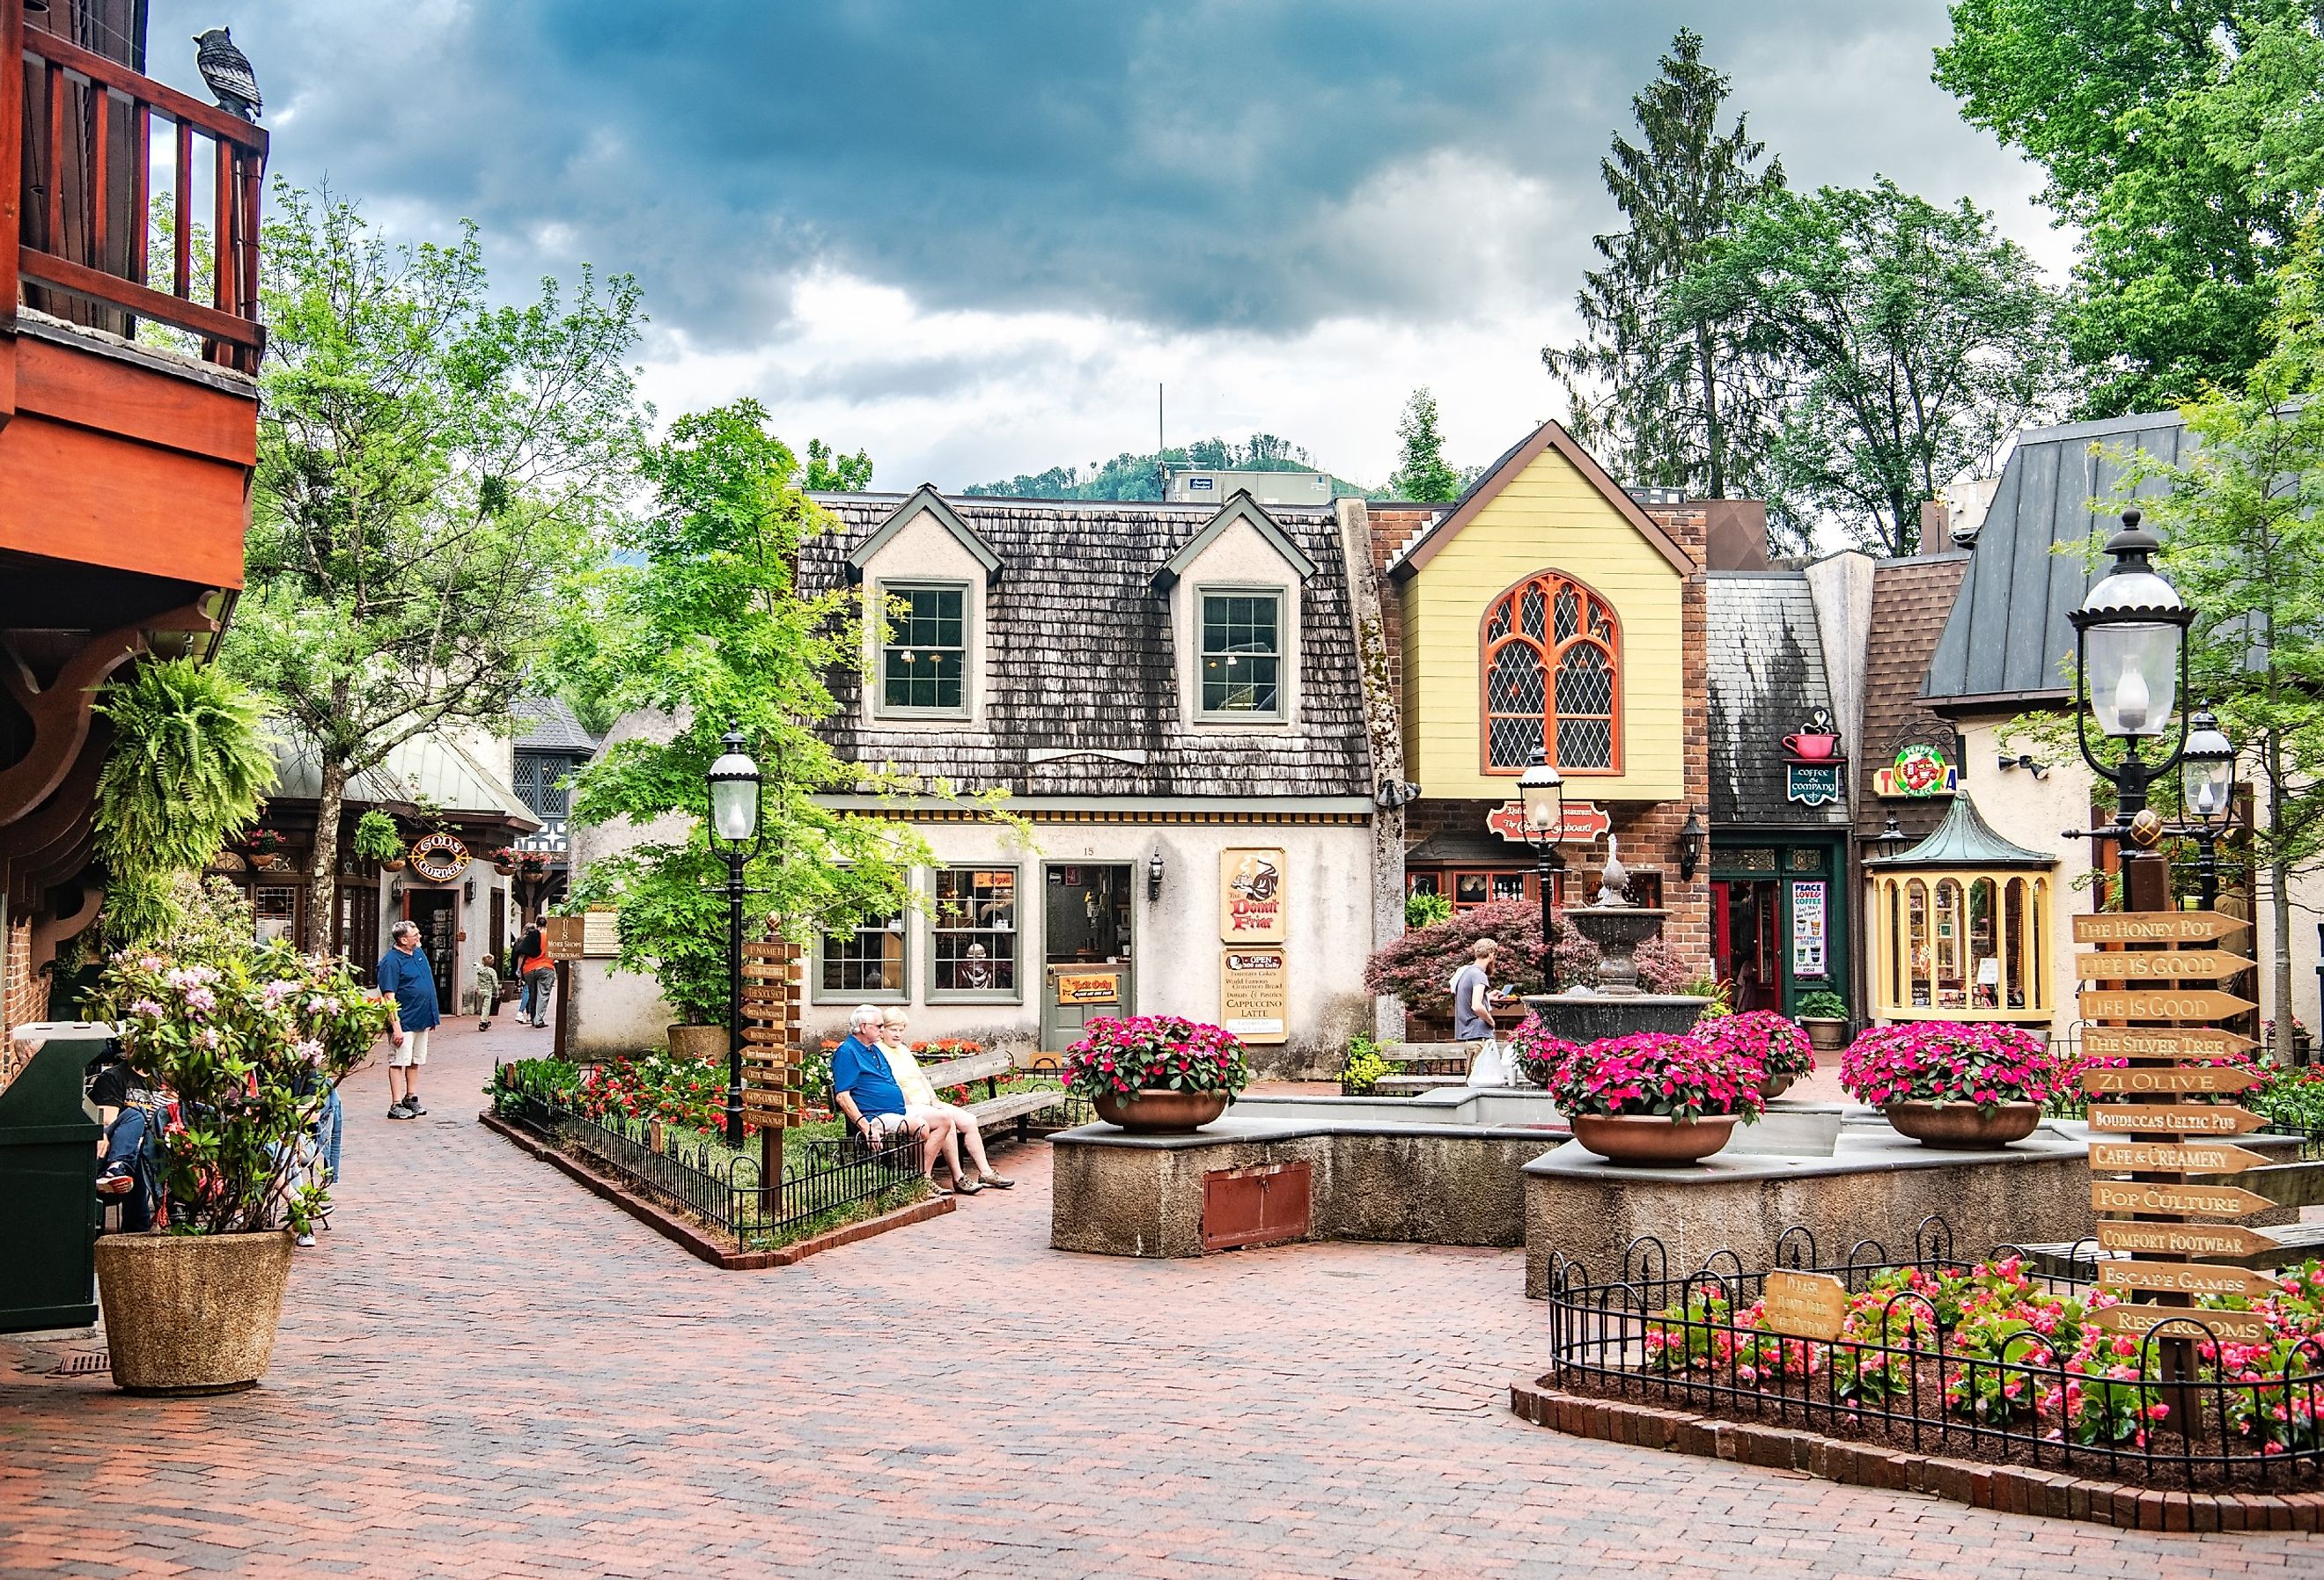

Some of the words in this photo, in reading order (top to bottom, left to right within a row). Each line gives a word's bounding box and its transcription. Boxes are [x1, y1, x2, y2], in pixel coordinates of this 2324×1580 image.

[1905, 746, 1935, 755] PEPPER
[1904, 786, 1934, 796] PALACE
[1504, 819, 1517, 828] The
[1084, 847, 1094, 856] 15
[419, 861, 466, 878] CORNER
[1230, 899, 1279, 915] Donut
[1231, 913, 1273, 930] Friar
[2078, 922, 2111, 937] THE
[2115, 921, 2175, 937] HONEY
[2180, 920, 2212, 936] POT
[757, 945, 776, 955] NAME
[2080, 959, 2123, 974] LIFE
[2129, 959, 2148, 974] IS
[2151, 958, 2217, 974] GOOD
[1092, 980, 1112, 990] Only
[749, 988, 758, 997] THE
[758, 988, 771, 999] SOCK
[771, 989, 784, 1000] SHOP
[2085, 997, 2124, 1016] LIFE
[2129, 997, 2145, 1016] IS
[2149, 996, 2210, 1016] GOOD
[2085, 1035, 2119, 1052] THE
[2122, 1036, 2180, 1053] SILVER
[2181, 1037, 2225, 1054] TREE
[747, 1070, 761, 1079] CELTIC
[762, 1071, 783, 1082] HERITAGE
[2131, 1074, 2216, 1090] OLIVE
[748, 1113, 783, 1125] RESTROOMS
[2095, 1111, 2164, 1127] BOUDICCA'S
[2166, 1113, 2207, 1128] CELTIC
[2211, 1113, 2236, 1129] PUB
[2095, 1145, 2130, 1165] CAFE
[2135, 1152, 2146, 1163] &
[2148, 1147, 2227, 1167] CREAMERY
[2100, 1188, 2139, 1207] POP
[2144, 1190, 2241, 1212] CULTURE
[2103, 1231, 2165, 1249] COMFORT
[2169, 1233, 2243, 1253] FOOTWEAR
[2105, 1268, 2173, 1287] ESCAPE
[2178, 1272, 2246, 1291] GAMES
[2117, 1312, 2261, 1338] RESTROOMS
